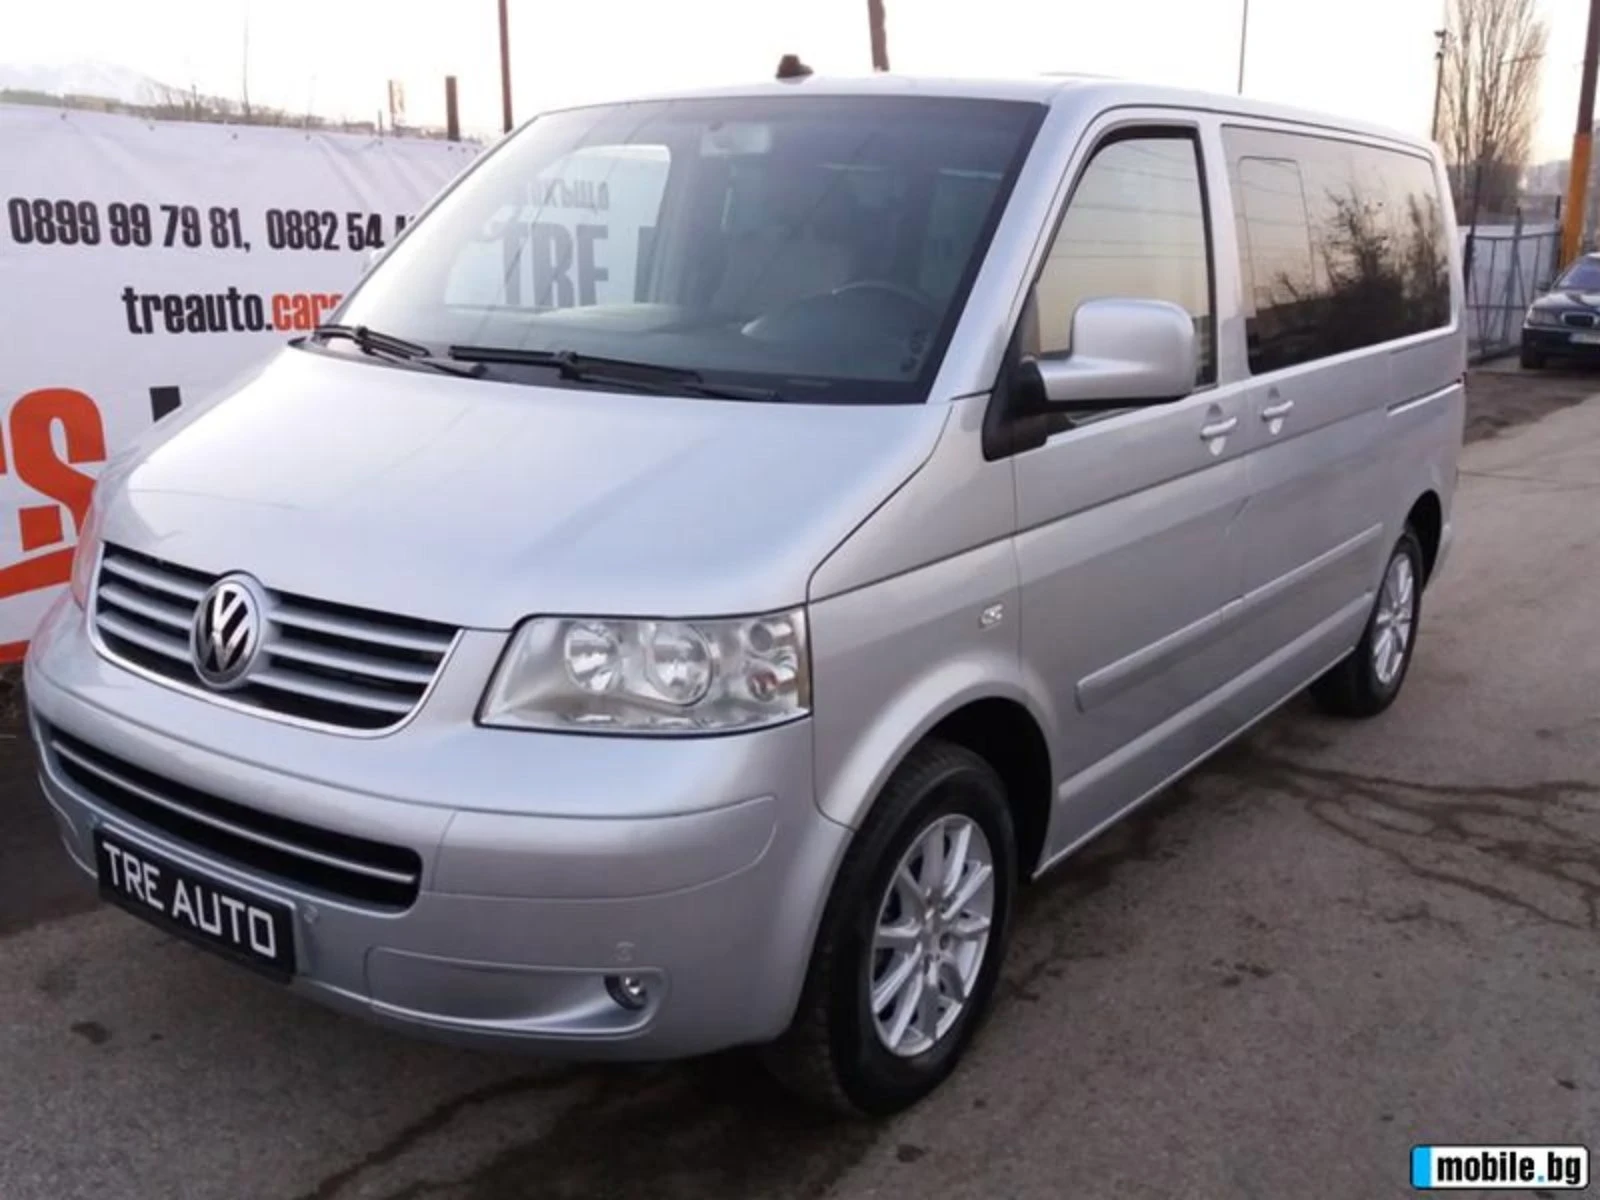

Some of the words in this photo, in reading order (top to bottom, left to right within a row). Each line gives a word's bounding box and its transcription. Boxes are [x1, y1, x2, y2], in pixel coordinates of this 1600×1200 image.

[8, 197, 100, 245] 0899
[107, 203, 152, 247] 99
[160, 204, 202, 249] 79
[209, 206, 250, 253] 81,
[266, 208, 340, 251] 0882
[346, 211, 385, 250] 54
[102, 841, 165, 911] TRE
[171, 878, 277, 959] AUTO
